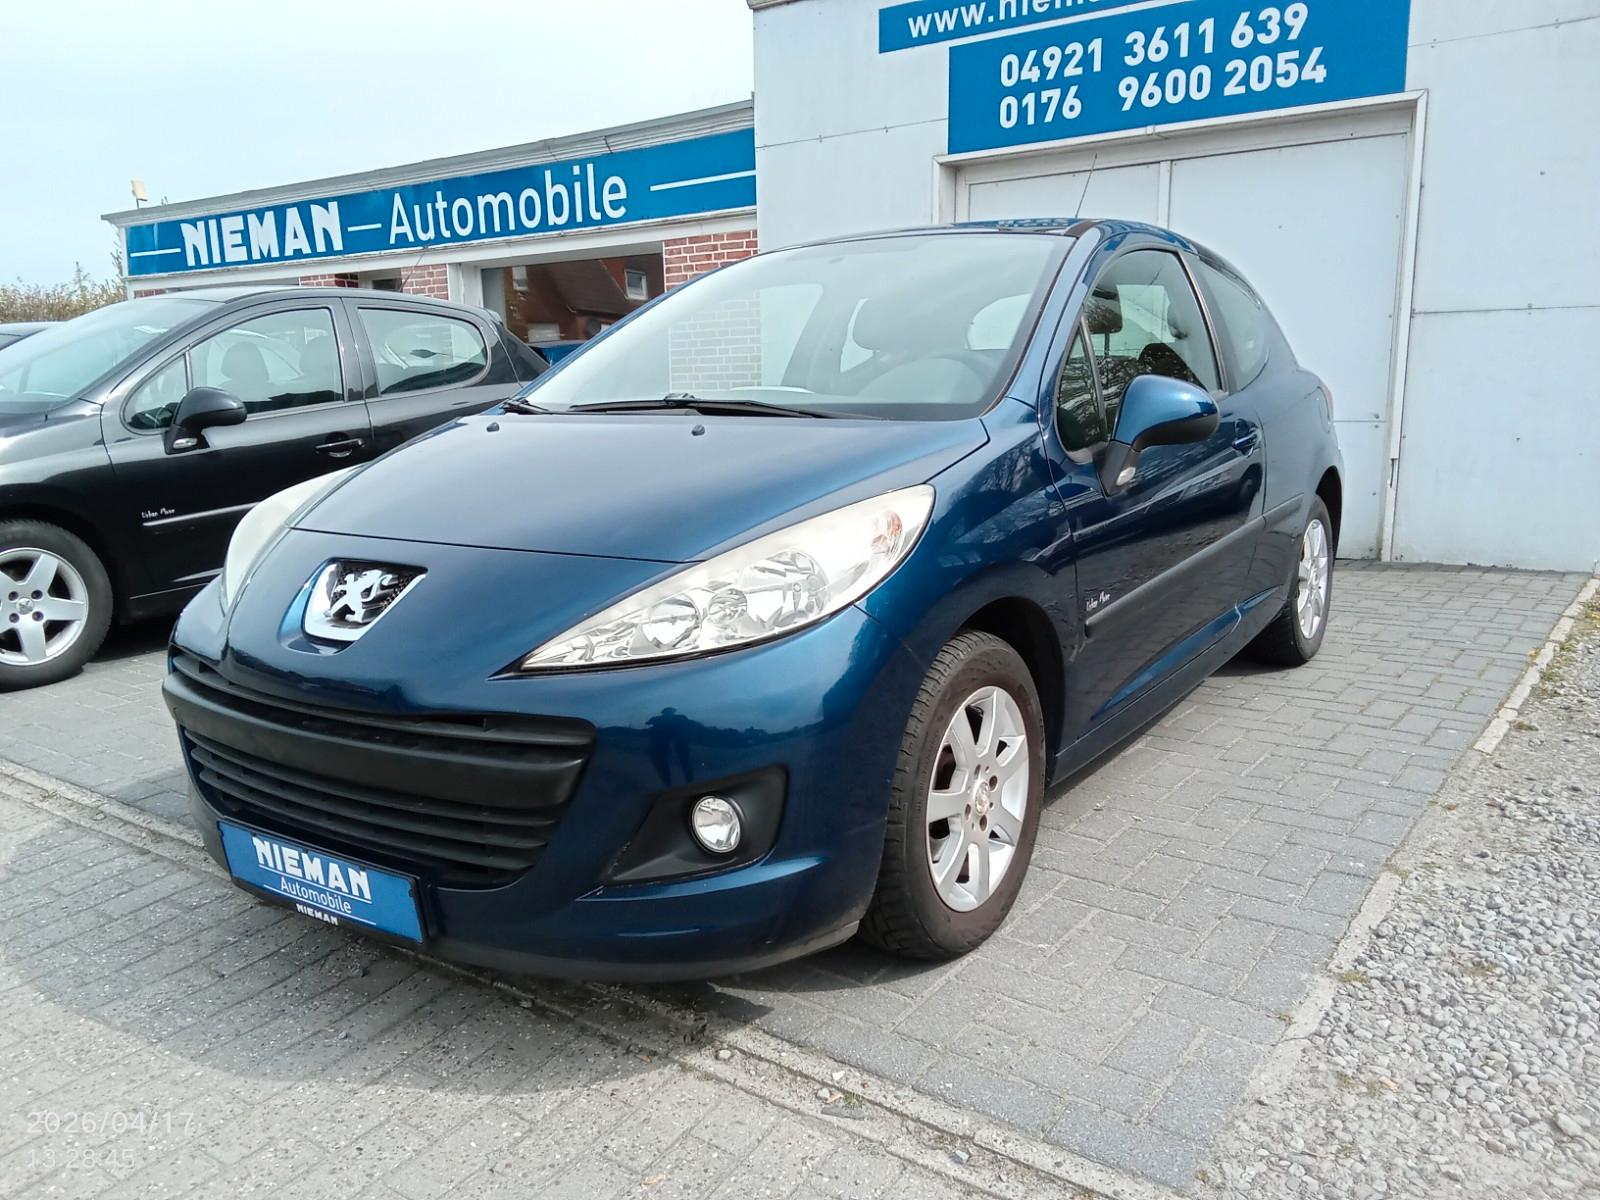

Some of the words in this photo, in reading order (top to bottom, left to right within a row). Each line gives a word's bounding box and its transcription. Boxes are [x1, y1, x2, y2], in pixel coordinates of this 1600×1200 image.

[1001, 38, 1102, 88] 04921
[1124, 18, 1215, 67] 3611
[1230, 4, 1309, 49] 639
[1000, 86, 1082, 129] 0176
[1119, 65, 1212, 112] 9600
[1224, 47, 1327, 97] 2054
[180, 201, 344, 267] NIEMAN
[389, 163, 629, 245] Automobile
[252, 836, 372, 900] NIEMAN
[280, 876, 352, 915] Automobile
[296, 903, 339, 926] NIEMAN
